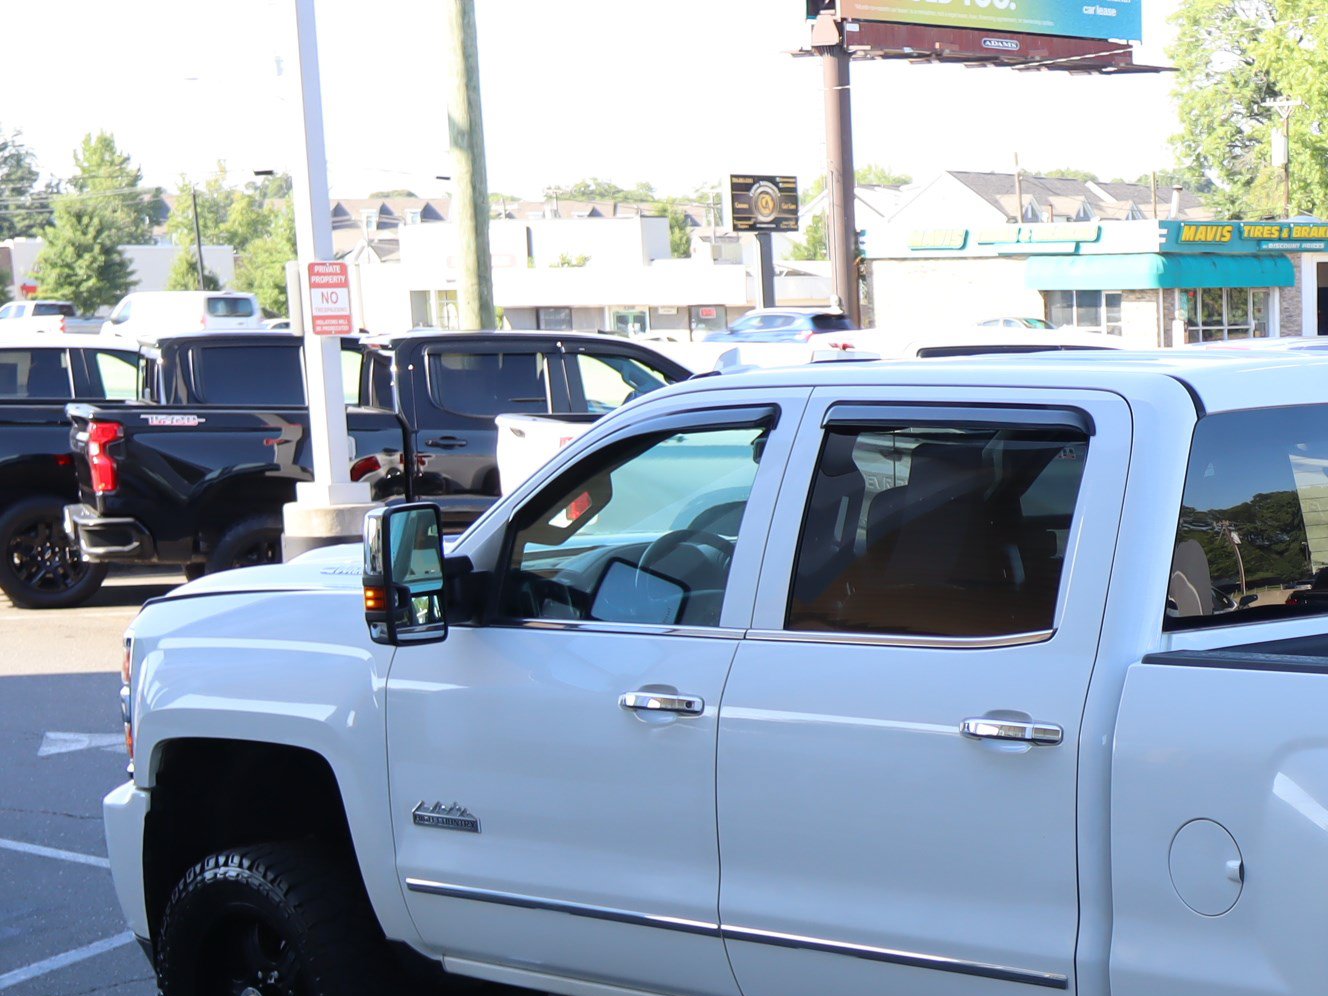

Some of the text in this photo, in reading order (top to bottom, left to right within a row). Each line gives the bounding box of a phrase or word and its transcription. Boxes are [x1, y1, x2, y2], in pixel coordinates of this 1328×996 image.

[1096, 5, 1117, 17] lease
[984, 40, 1017, 49] ADAMS
[1181, 225, 1234, 242] MAVIS
[1243, 225, 1281, 239] TIRES
[1281, 227, 1290, 239] &
[314, 264, 342, 273] PRIVATE
[311, 275, 346, 284] PROPERTY
[321, 291, 339, 304] NO
